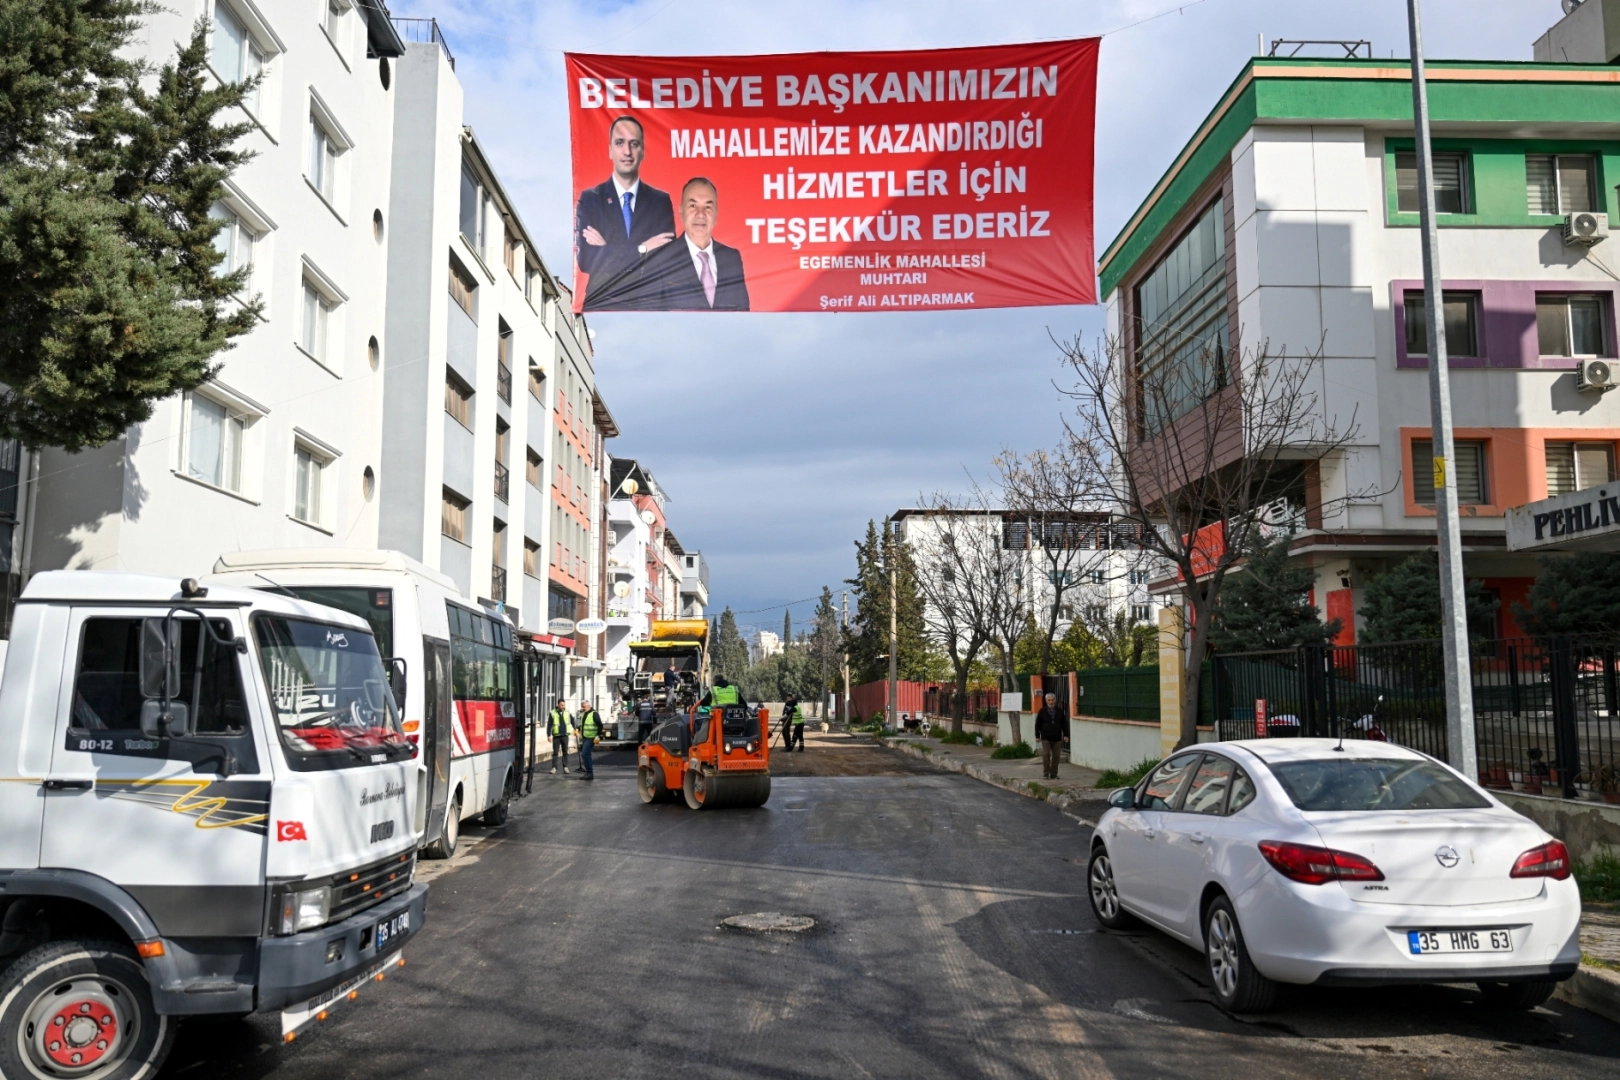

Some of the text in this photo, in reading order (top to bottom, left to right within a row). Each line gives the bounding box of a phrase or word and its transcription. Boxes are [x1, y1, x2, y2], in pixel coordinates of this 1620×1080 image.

[579, 65, 1058, 113] BELEDİYE BAŞKANIMIZIN
[670, 112, 1043, 158] MAHALLEMİZE KAZANDIRDIĞI
[762, 162, 1027, 201] HİZMETLER İÇİN
[745, 207, 1051, 250] TEŞEKKÜR EDERİZ
[800, 252, 986, 269] EGEMENLİK MAHALLESİ
[860, 273, 927, 285] MUHTARI
[820, 292, 975, 309] Şerif Ali ALTIPARMAK
[79, 739, 114, 750] 80-12
[1419, 933, 1440, 951] 35
[1450, 932, 1480, 950] HMG
[1490, 931, 1510, 949] 63
